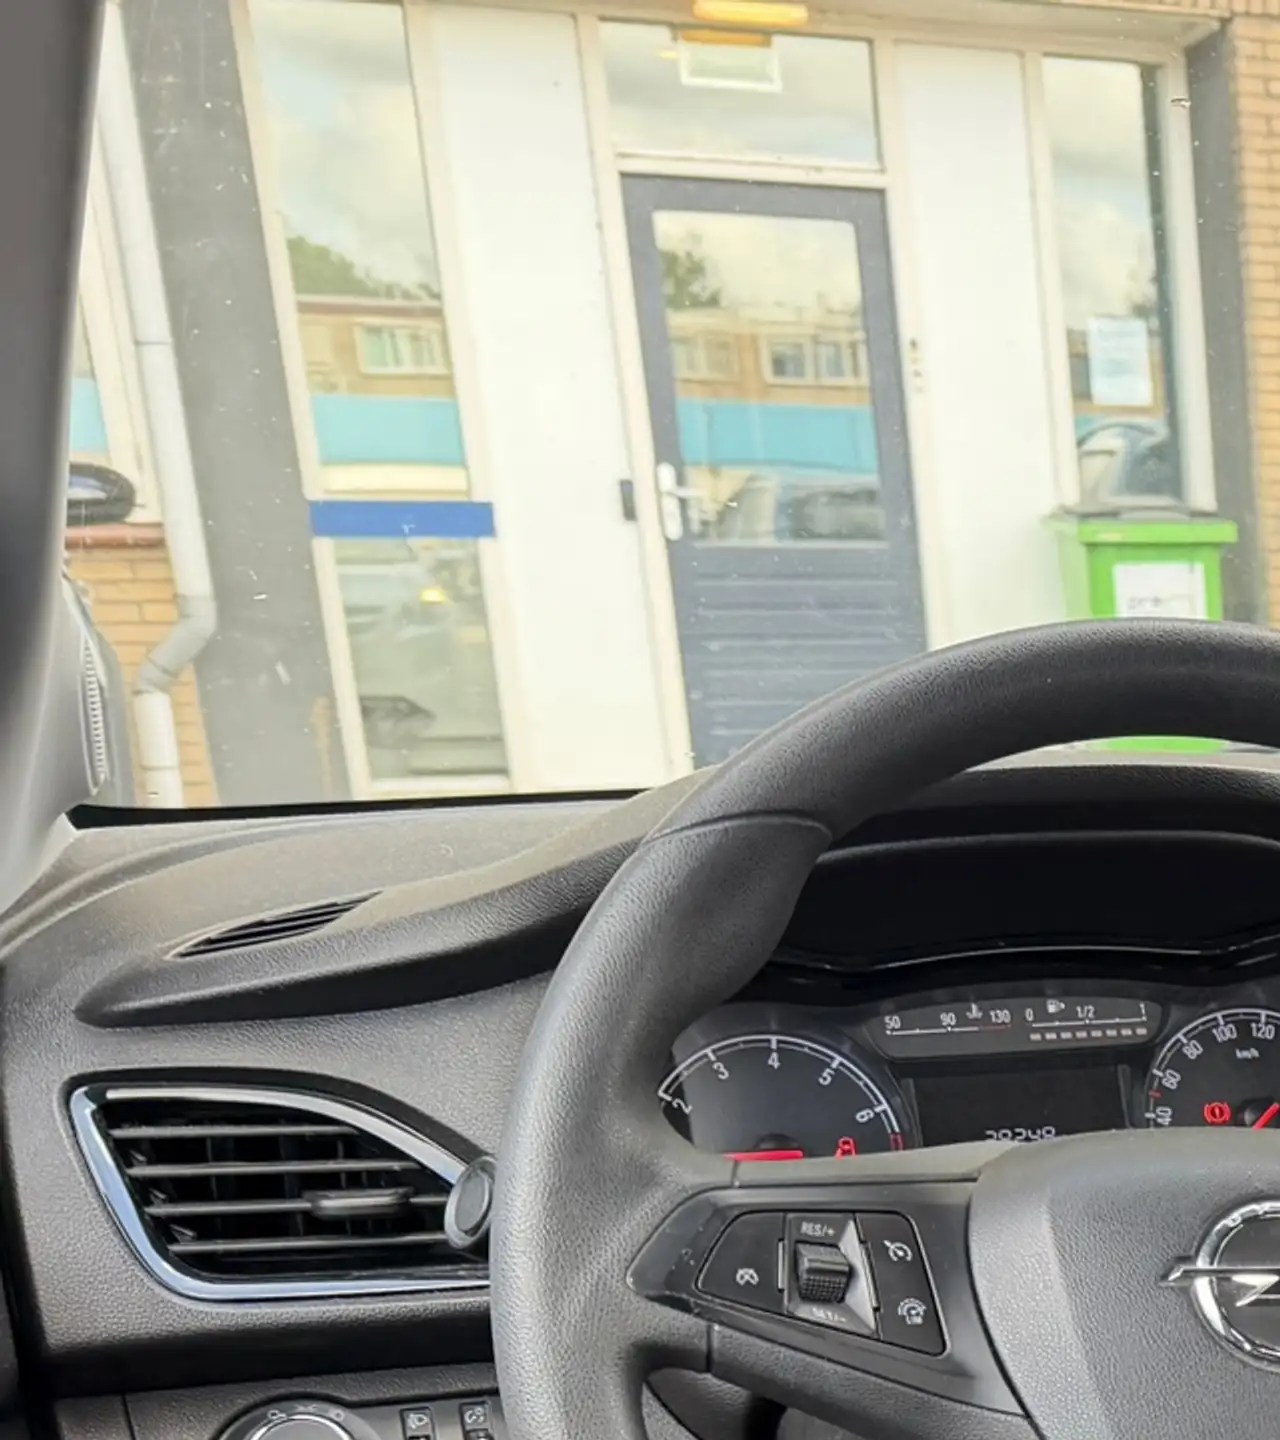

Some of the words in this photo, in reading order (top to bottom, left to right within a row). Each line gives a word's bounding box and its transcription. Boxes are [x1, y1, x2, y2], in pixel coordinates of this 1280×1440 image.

[940, 1012, 957, 1026] 90
[989, 1009, 1011, 1024] 130
[1076, 1005, 1095, 1019] 1/2
[884, 1015, 902, 1029] 50
[1212, 1023, 1238, 1044] 100
[1251, 1022, 1275, 1040] 120
[1182, 1039, 1204, 1060] 80
[767, 1052, 781, 1070] 4
[712, 1061, 730, 1081] 3
[818, 1070, 833, 1086] 5
[1161, 1069, 1182, 1090] 60
[672, 1098, 692, 1115] 2
[855, 1109, 875, 1124] 6
[1156, 1106, 1173, 1126] 40
